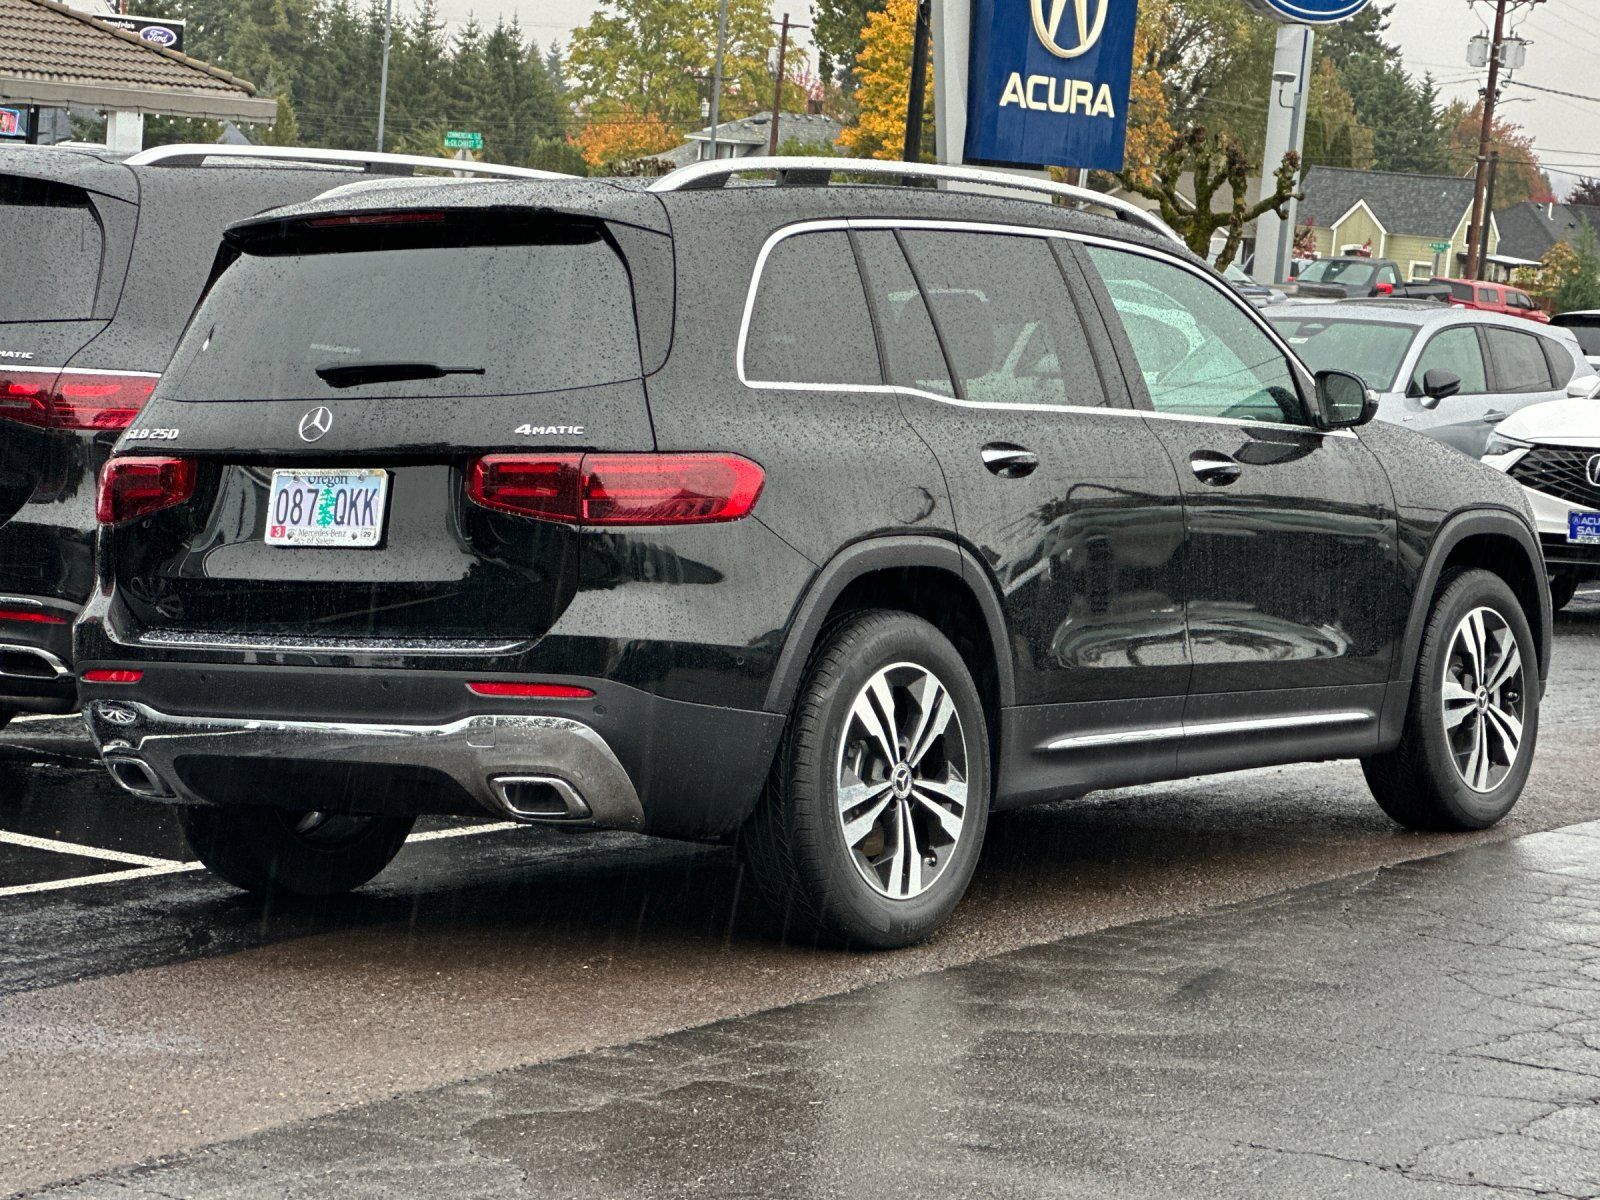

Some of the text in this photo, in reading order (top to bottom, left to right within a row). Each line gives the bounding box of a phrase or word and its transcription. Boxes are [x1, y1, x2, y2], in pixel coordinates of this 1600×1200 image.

[147, 29, 168, 43] Ford
[999, 71, 1115, 118] ACURA
[150, 429, 179, 440] 250
[514, 423, 584, 435] 4MATIC
[308, 475, 348, 488] Oregon
[276, 488, 378, 526] 087 QKK
[298, 528, 347, 538] Mercedes-Benz
